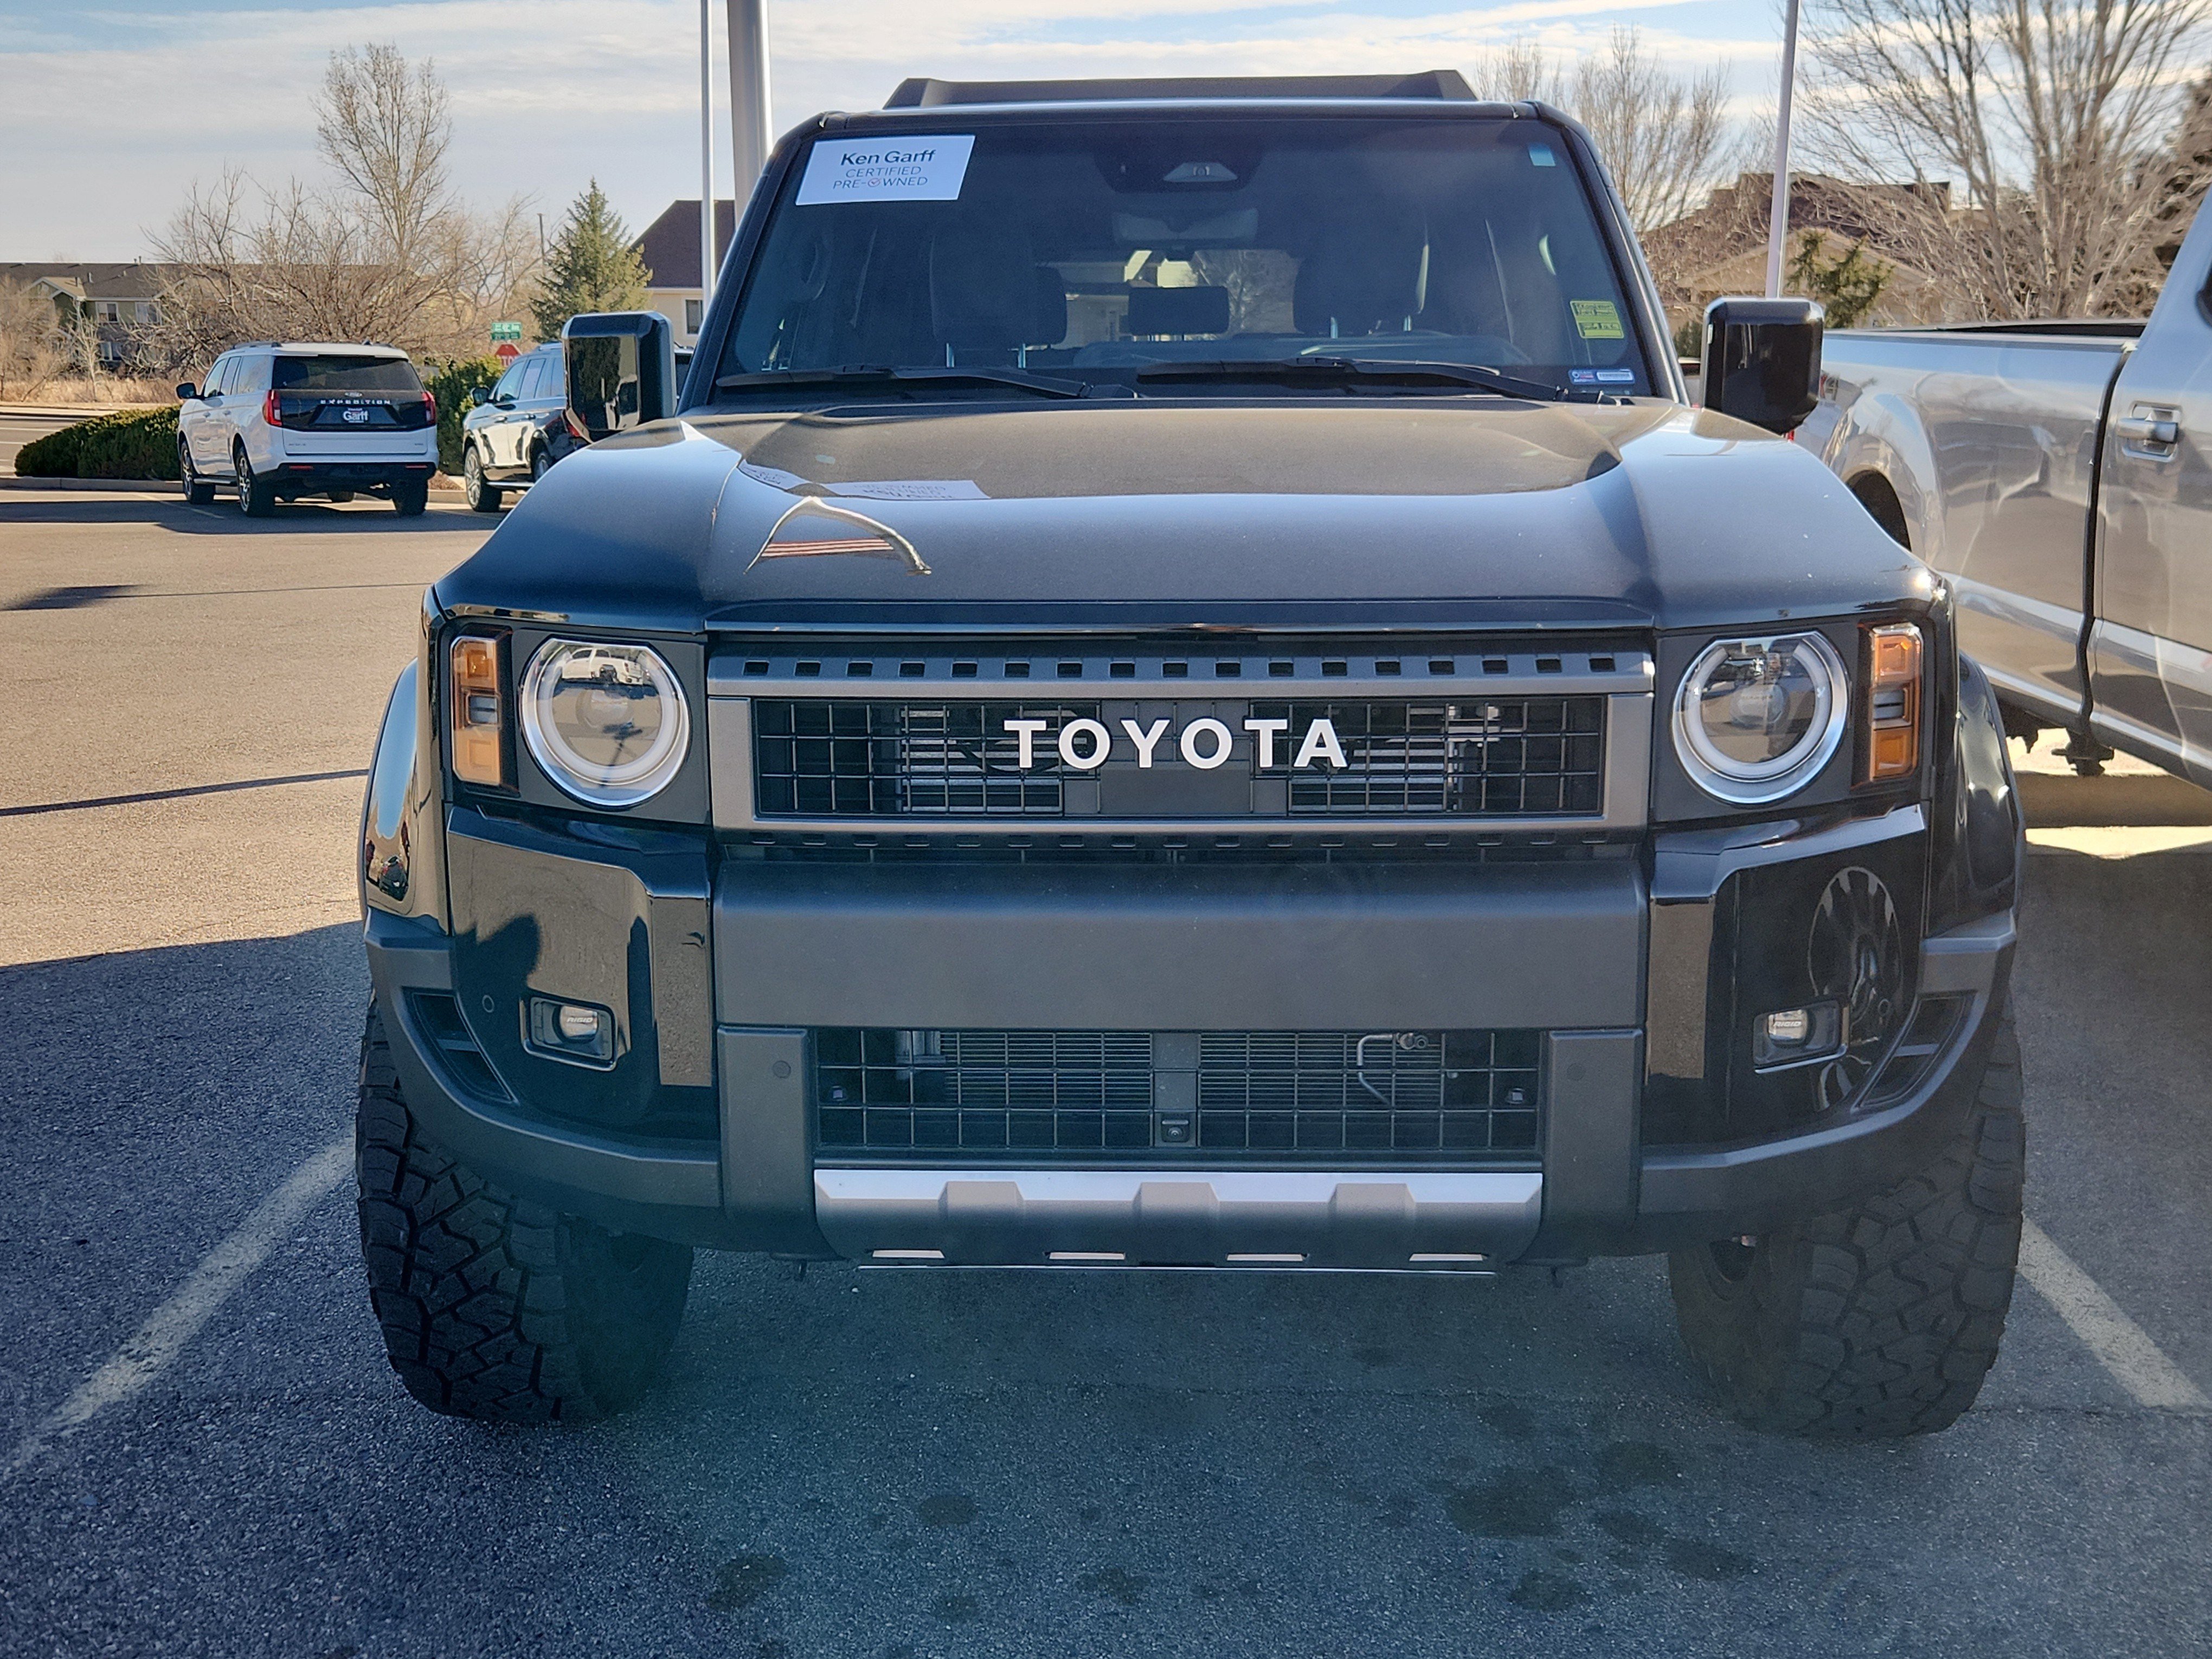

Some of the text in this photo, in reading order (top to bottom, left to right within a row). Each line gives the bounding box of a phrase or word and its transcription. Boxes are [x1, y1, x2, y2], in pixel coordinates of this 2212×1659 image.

[840, 149, 936, 166] Ken Garff
[845, 166, 922, 178] CERTIFIED
[1003, 718, 1348, 770] TOYOTA
